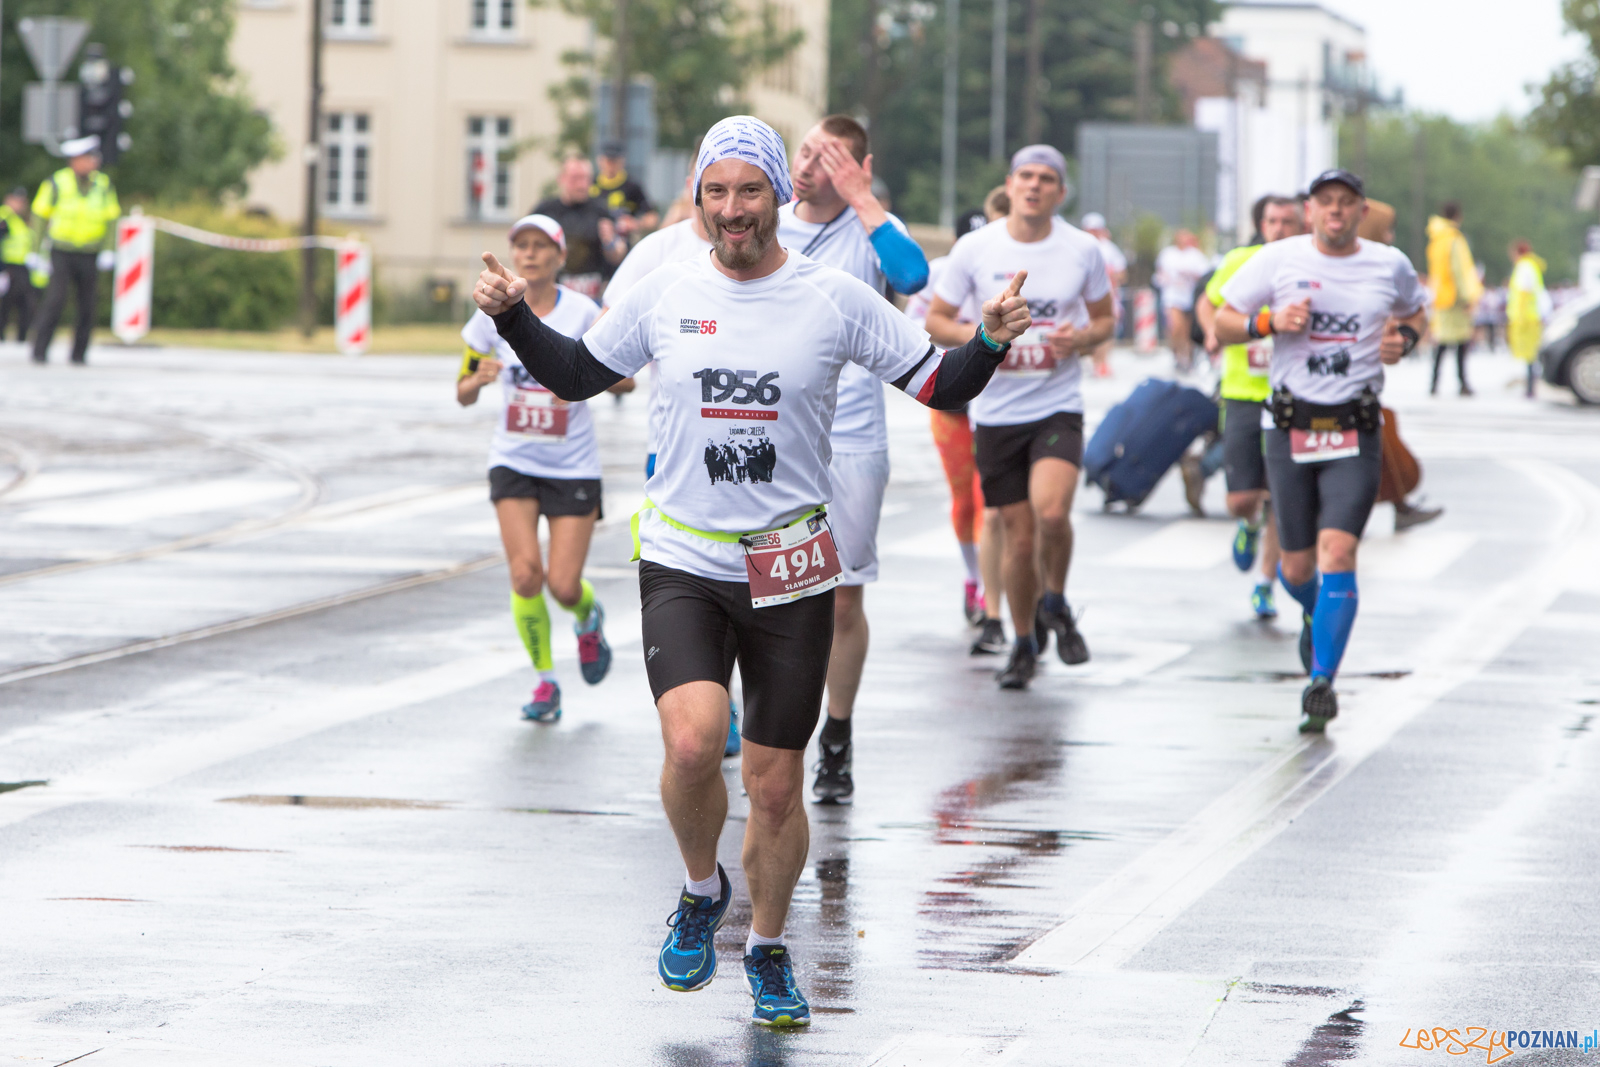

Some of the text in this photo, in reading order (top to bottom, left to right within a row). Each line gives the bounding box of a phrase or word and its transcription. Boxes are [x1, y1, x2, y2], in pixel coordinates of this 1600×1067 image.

[1309, 311, 1360, 333] 1956
[1009, 346, 1046, 367] 719
[692, 367, 782, 406] 1956
[516, 405, 554, 429] 313
[769, 541, 826, 581] 494
[785, 574, 821, 591] SŁAWOMIR
